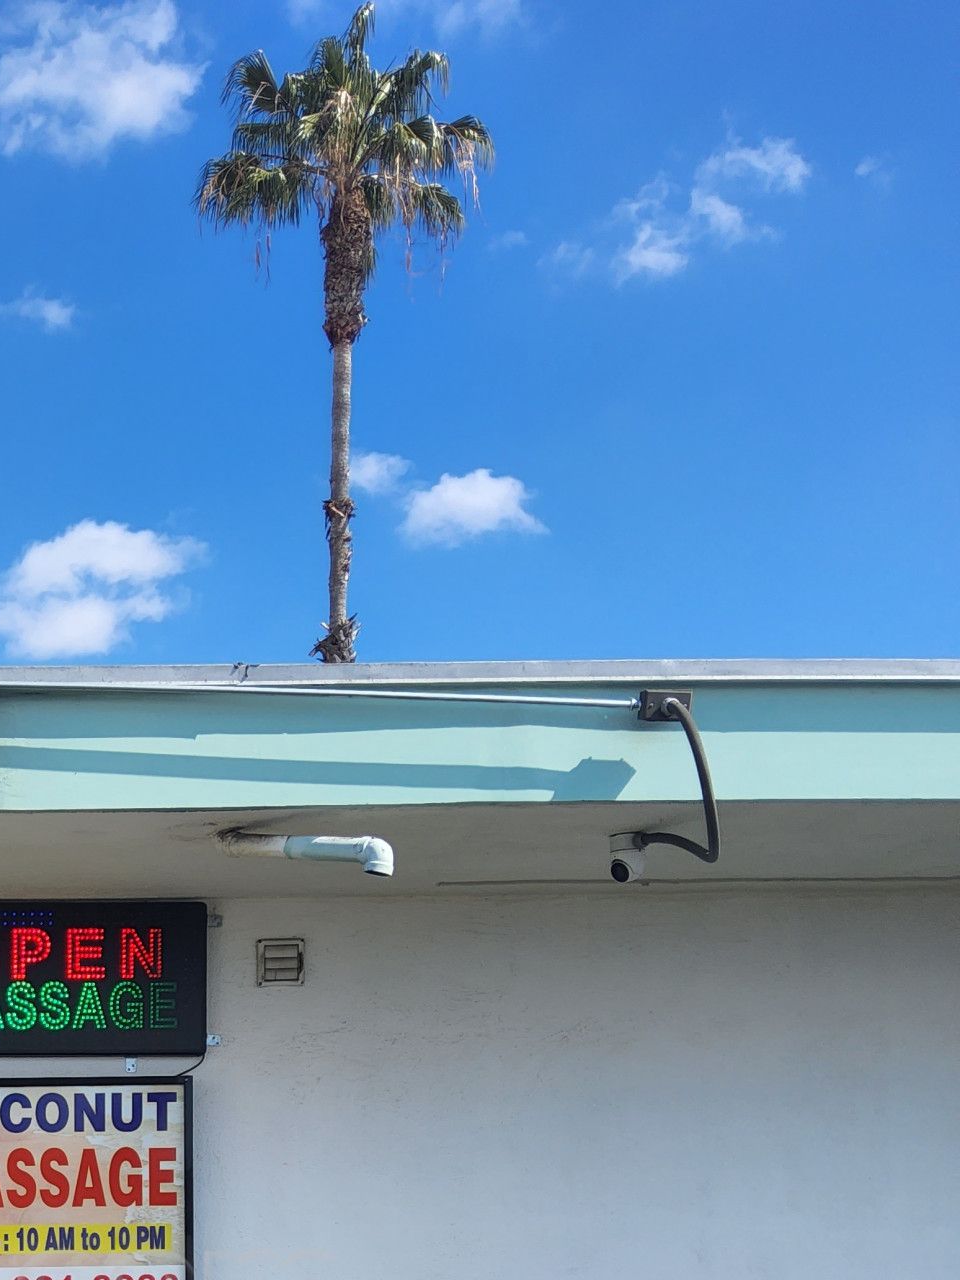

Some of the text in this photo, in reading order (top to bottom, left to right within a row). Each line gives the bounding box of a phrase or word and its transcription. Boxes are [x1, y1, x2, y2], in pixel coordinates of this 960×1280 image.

[16, 1227, 38, 1251] 10
[45, 1226, 75, 1251] AM
[81, 1227, 100, 1250] to
[108, 1226, 130, 1250] 10
[136, 1225, 166, 1250] PM
